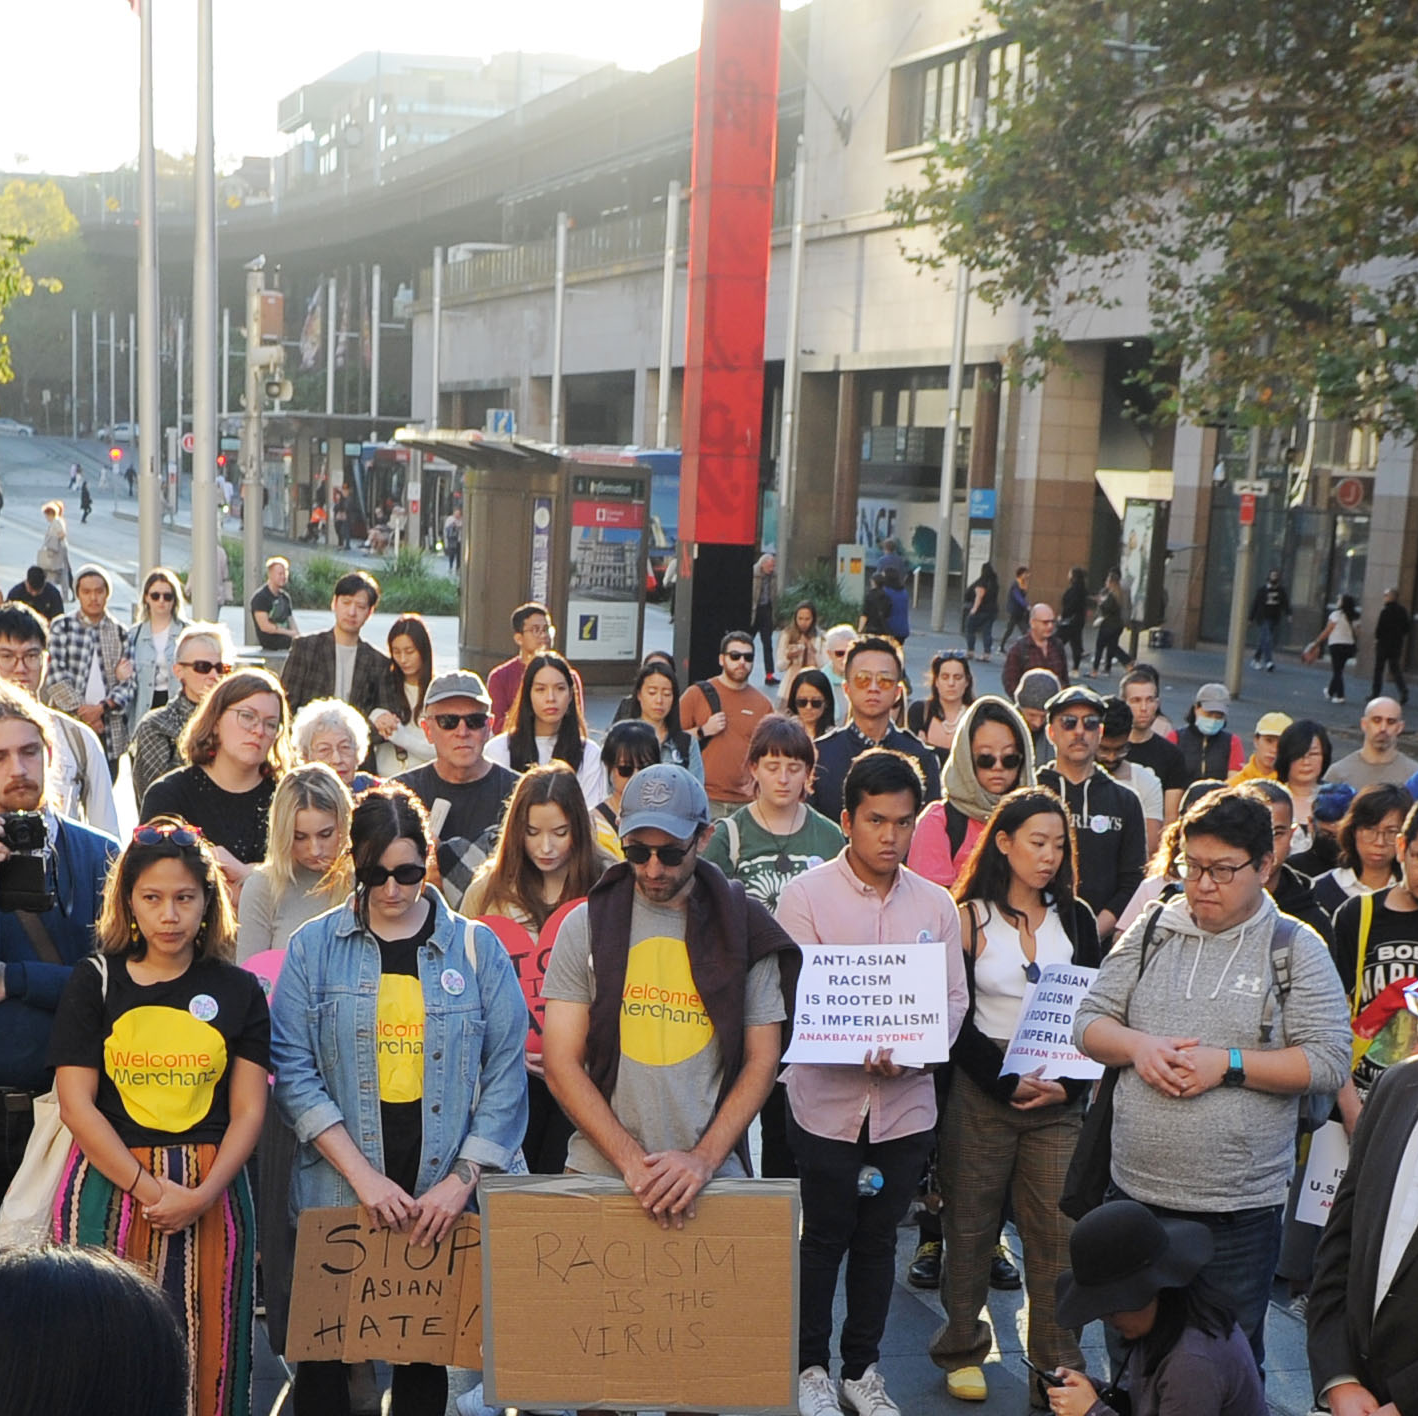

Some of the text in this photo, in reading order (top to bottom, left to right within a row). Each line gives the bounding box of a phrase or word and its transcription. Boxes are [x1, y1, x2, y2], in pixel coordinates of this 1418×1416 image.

[812, 954, 907, 967] ANTI-ASIAN
[828, 974, 891, 986] RACISM
[805, 994, 916, 1006] IS ROOTED IN
[795, 1013, 940, 1027] .S. IMPERIALISM!
[376, 1022, 424, 1038] lcom
[798, 1032, 925, 1043] ANAKBAYAN SYDNEY
[377, 1038, 423, 1056] rcha
[110, 1050, 211, 1068] Welcome
[1051, 1051, 1090, 1061] SYDNE
[112, 1068, 217, 1087] Merchant
[1310, 1180, 1335, 1195] U.S
[321, 1223, 481, 1276] STOP
[533, 1231, 737, 1286] RACISM
[361, 1277, 443, 1303] ASIAN
[605, 1288, 714, 1314] IS THE
[572, 1321, 705, 1360] VIRUS
